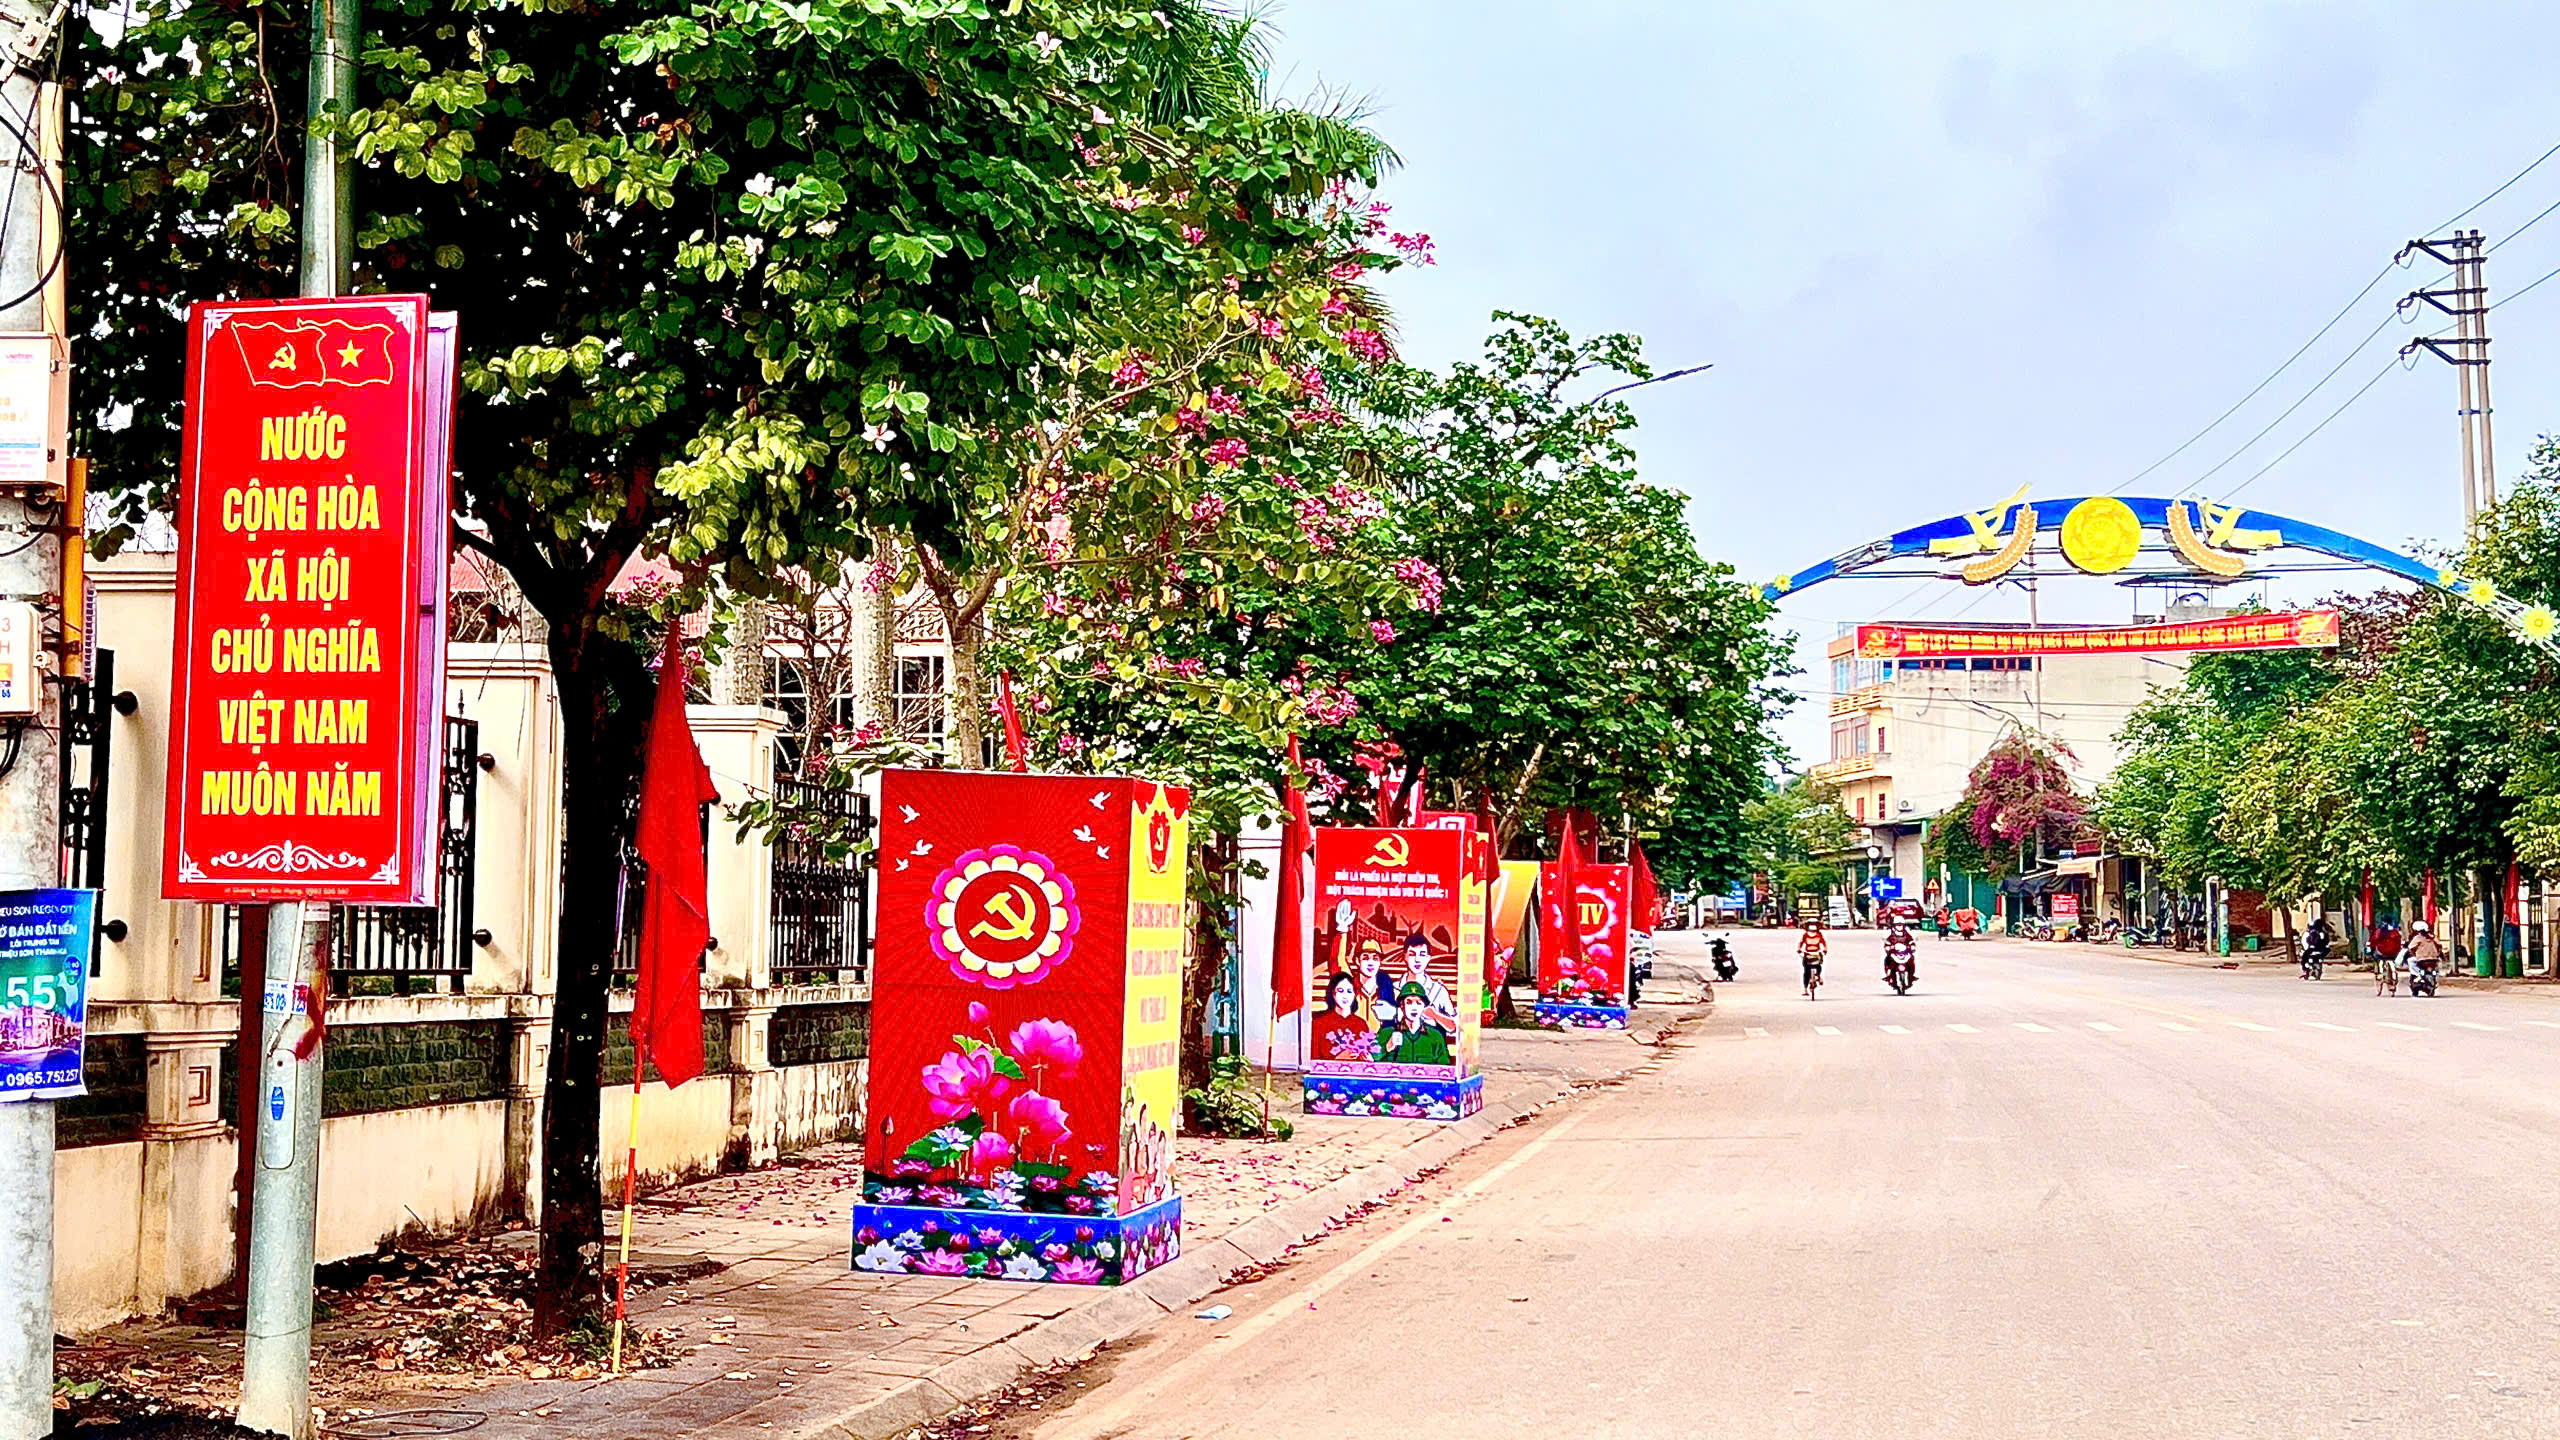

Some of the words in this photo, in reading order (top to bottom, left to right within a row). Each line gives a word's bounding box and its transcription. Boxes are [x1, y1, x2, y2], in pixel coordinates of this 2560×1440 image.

[261, 406, 347, 461] NƯỚC
[223, 480, 307, 542] CỘNG
[317, 474, 380, 530] HÒA
[245, 548, 287, 602] XÃ
[297, 547, 349, 612] HỘI
[212, 614, 274, 673] CHỦ
[284, 618, 380, 673] NGHĨA
[219, 690, 286, 755] VIỆT
[294, 699, 368, 745] NAM
[202, 761, 297, 817] MUÔN
[306, 761, 381, 817] NĂM
[1577, 903, 1605, 925] IV
